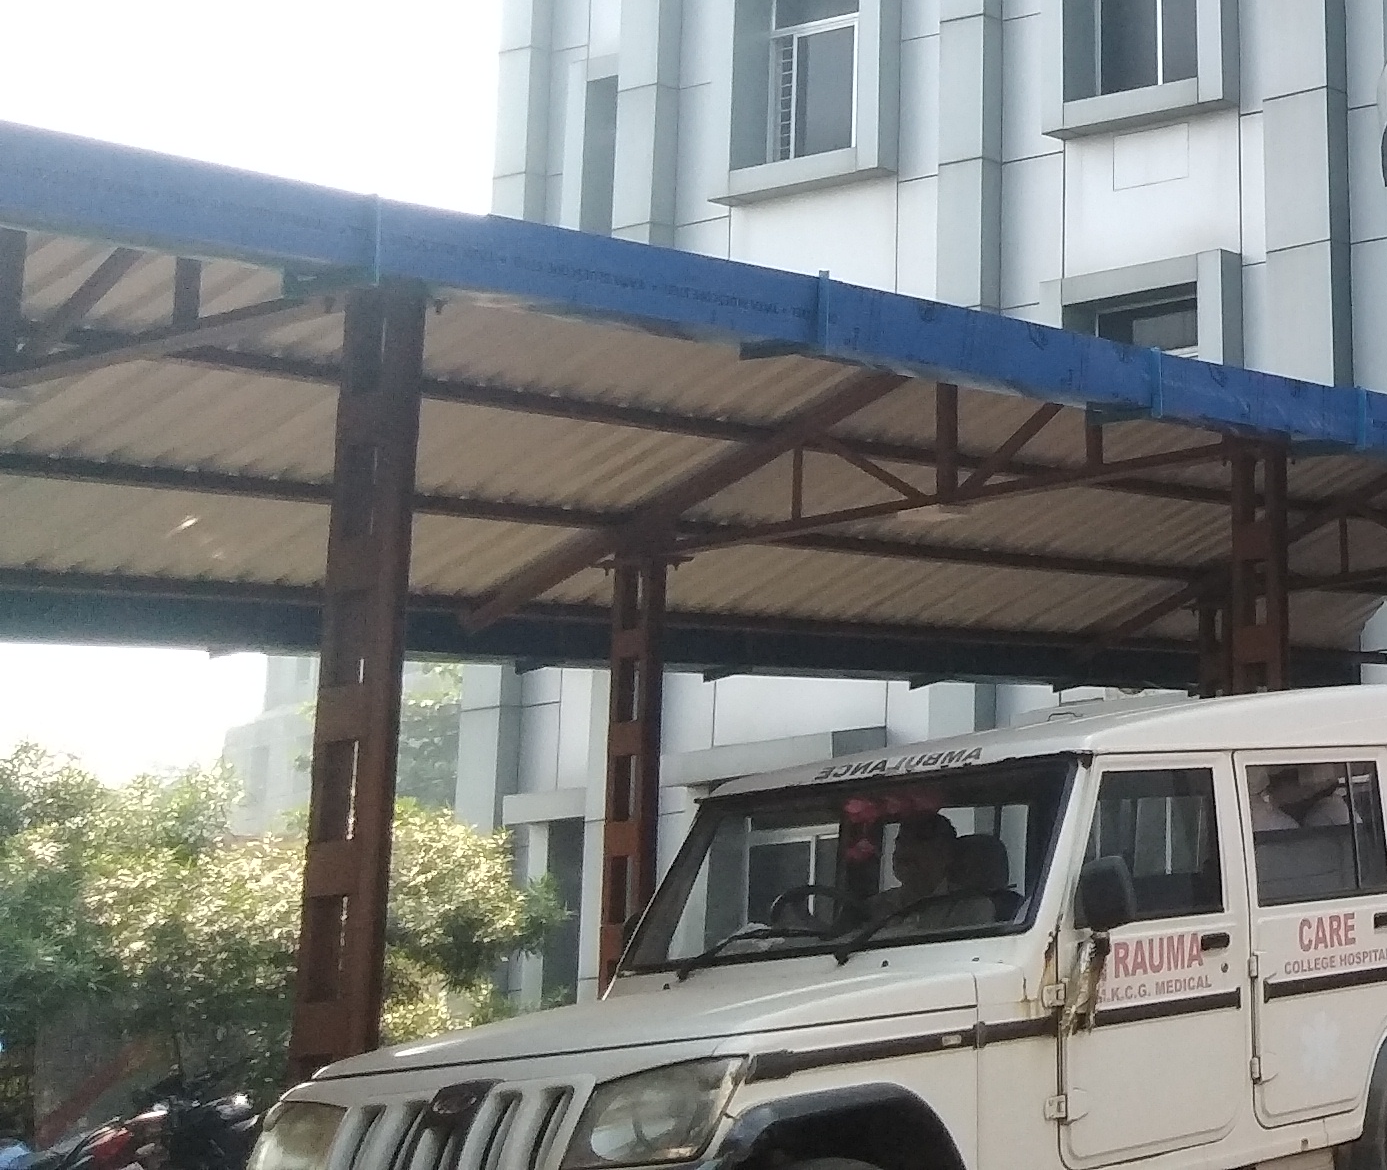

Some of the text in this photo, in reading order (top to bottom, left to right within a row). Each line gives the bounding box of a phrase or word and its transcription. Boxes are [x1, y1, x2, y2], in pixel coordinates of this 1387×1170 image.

[1098, 933, 1204, 982] RAUMA
[1299, 912, 1356, 952] CARE
[1155, 975, 1213, 996] MEDICAL
[1284, 955, 1336, 975] COLLEGE
